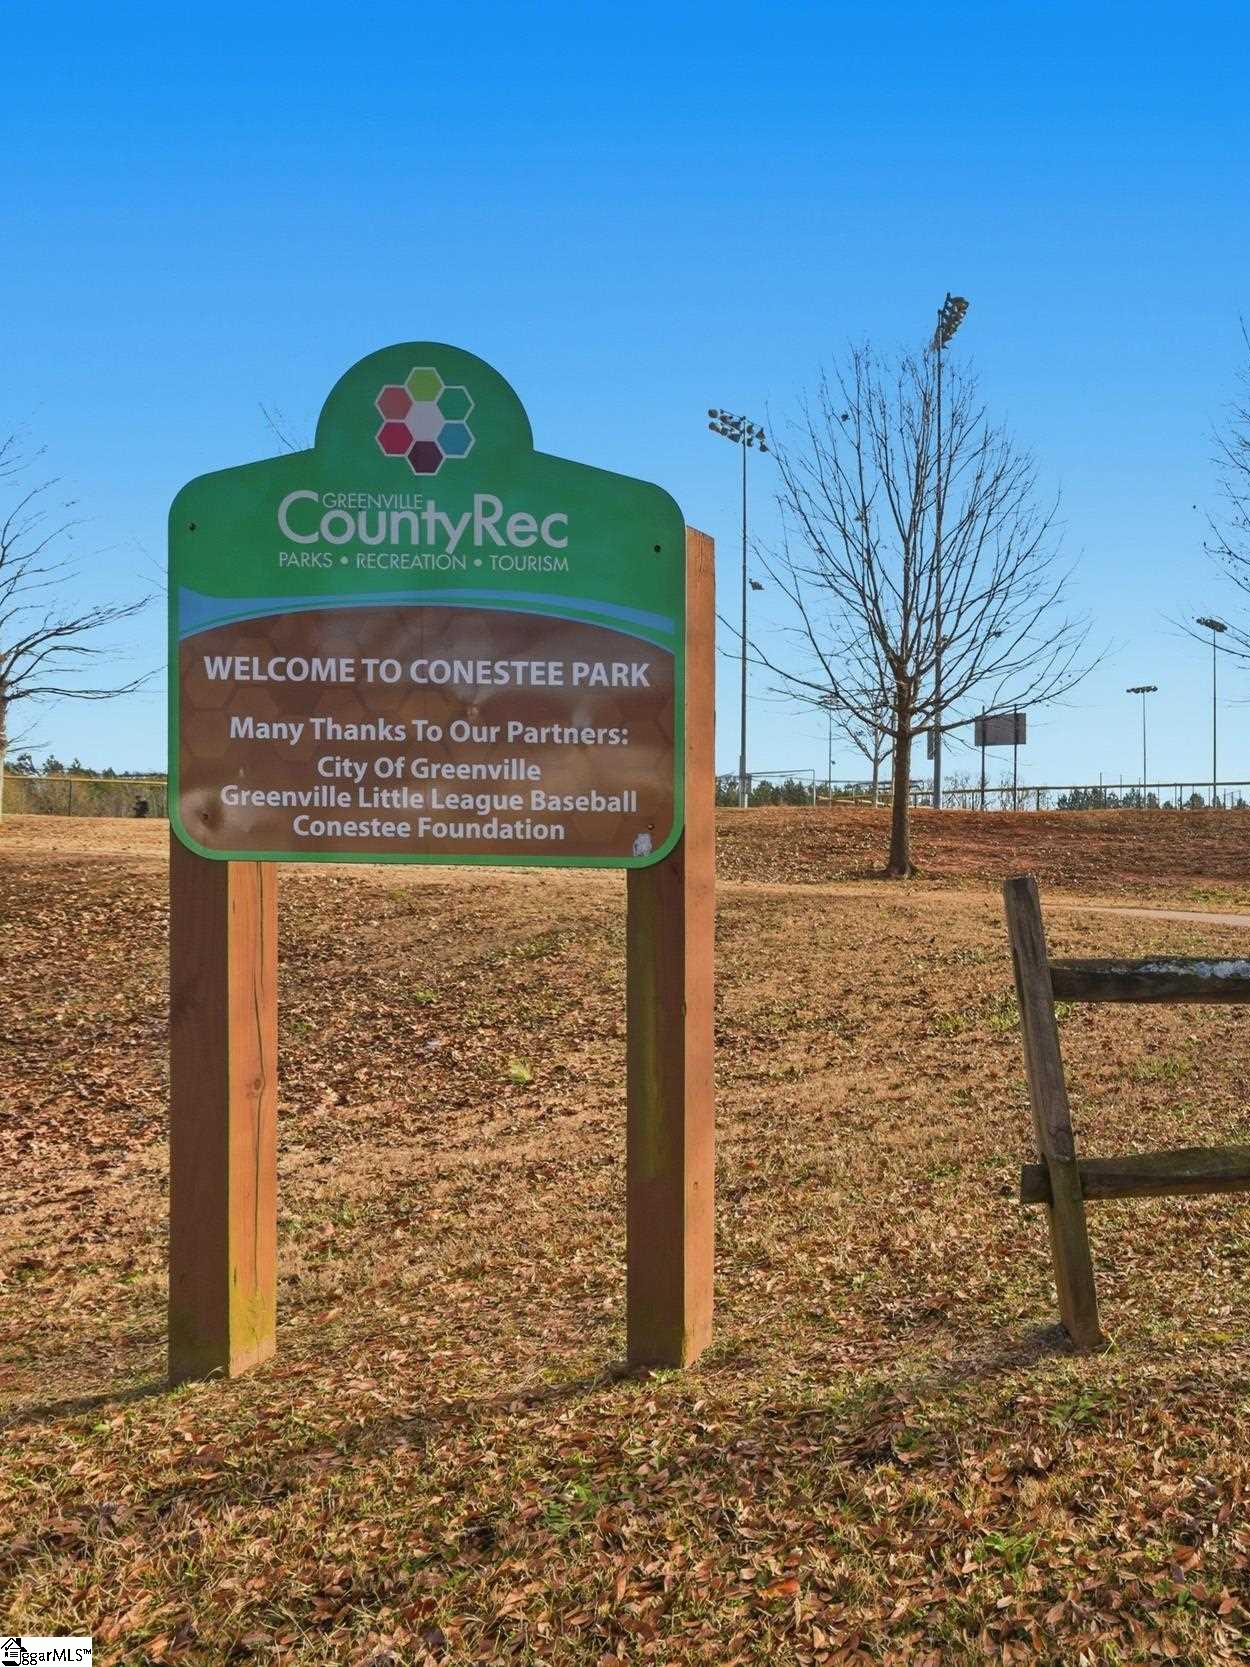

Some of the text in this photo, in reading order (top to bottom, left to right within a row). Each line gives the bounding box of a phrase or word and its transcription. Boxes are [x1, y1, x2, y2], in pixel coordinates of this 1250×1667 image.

[323, 493, 423, 509] GREENVILLE
[278, 490, 569, 554] CountyRec
[279, 552, 569, 572] PARKS RECREATION TOURISM
[204, 656, 650, 687] WELCOME TO CONESTEE PARK
[230, 716, 628, 745] Many Thanks To Our Partners:
[318, 757, 541, 783] City Of Greenville
[220, 785, 636, 816] Greenville Little League Baseball
[294, 815, 564, 840] Conestee Foundation
